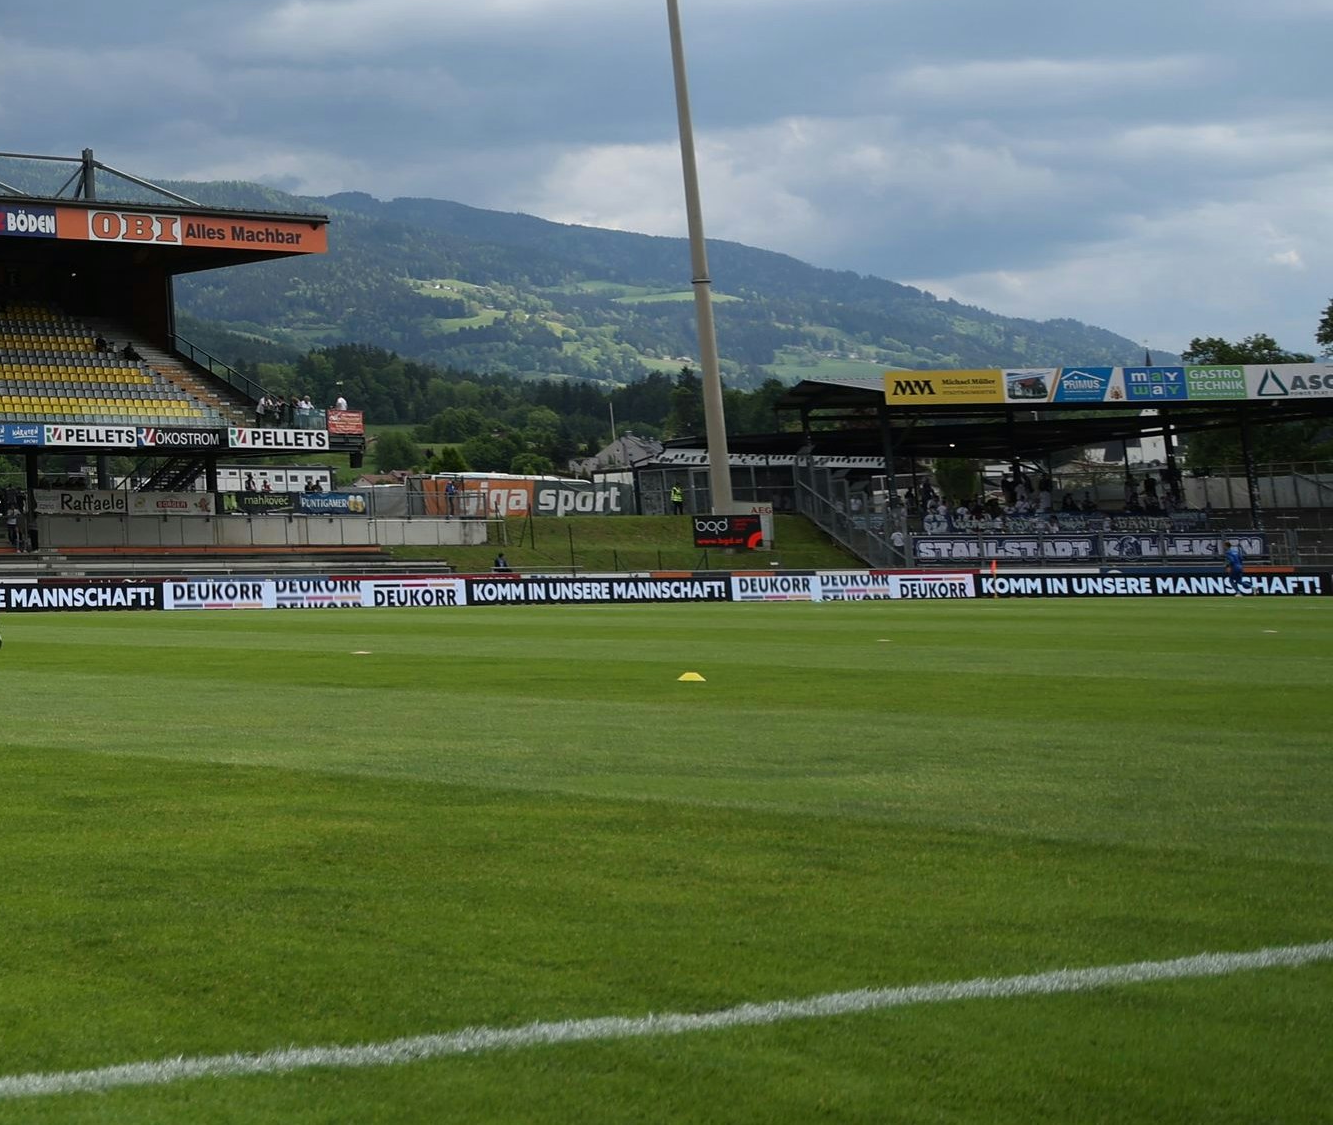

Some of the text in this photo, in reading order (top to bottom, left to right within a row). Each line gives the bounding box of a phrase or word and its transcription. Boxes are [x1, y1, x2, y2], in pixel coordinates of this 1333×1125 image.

[7, 209, 56, 234] BÖDEN
[91, 211, 178, 243] OBI
[185, 222, 302, 246] Alles Machbar
[1189, 369, 1241, 379] GASTRO
[1063, 379, 1100, 389] PRIMUS
[1188, 380, 1245, 390] TECHNIK
[65, 429, 134, 443] PELLETS
[156, 430, 219, 445] ÖKOSTROM
[251, 431, 326, 447] PELLETS
[61, 493, 124, 511] Raffaele
[301, 497, 347, 508] PUNTIGAMER
[460, 482, 621, 516] giga sport
[751, 506, 773, 514] AEG
[919, 540, 1090, 558] STAHLSTADT
[276, 580, 361, 593] DEUKORR
[739, 577, 811, 593] DEUKORR
[821, 575, 889, 587] DEUKORR
[982, 576, 1322, 595] KOMM IN UNSERE MANNSCHAFT!
[10, 587, 155, 608] MANNSCHAFT!
[173, 583, 262, 601] DEUKORR
[374, 588, 457, 606] DEUKORR
[473, 581, 726, 601] KOMM IN UNSERE MANNSCHAFT!
[900, 583, 967, 598] DEUKORR
